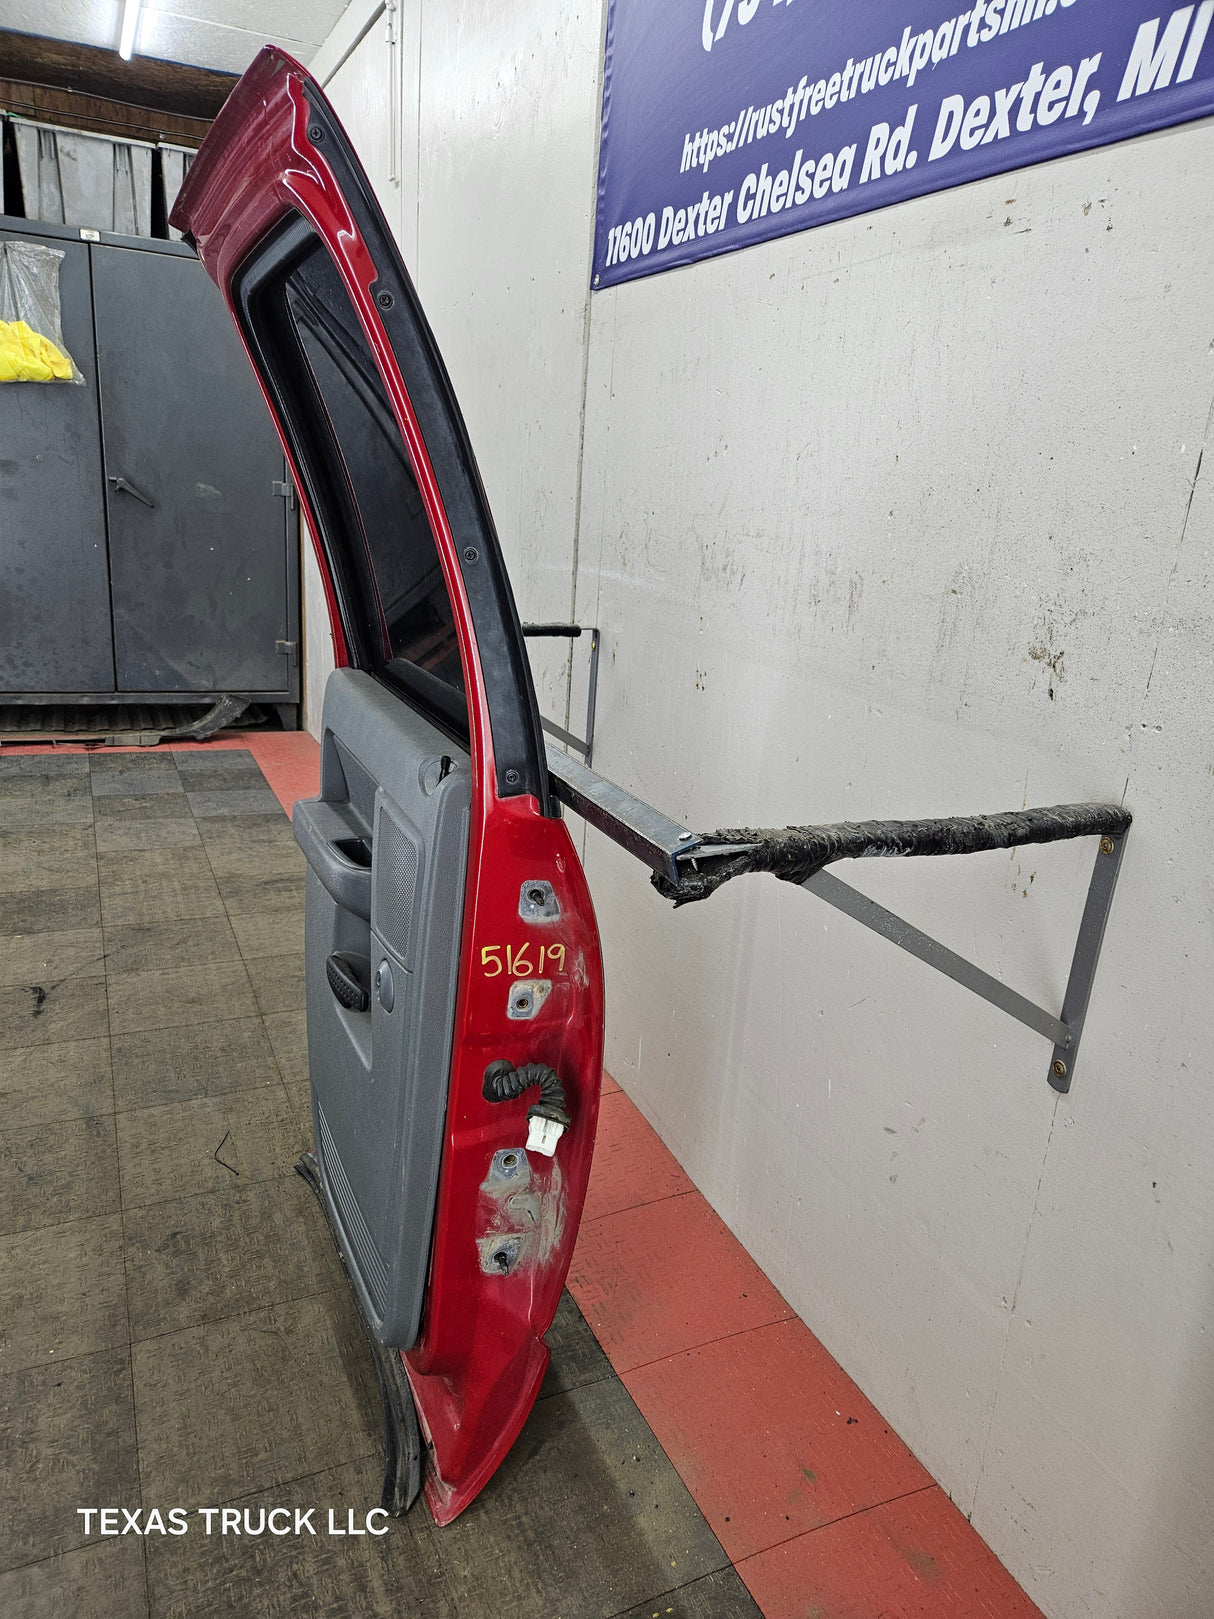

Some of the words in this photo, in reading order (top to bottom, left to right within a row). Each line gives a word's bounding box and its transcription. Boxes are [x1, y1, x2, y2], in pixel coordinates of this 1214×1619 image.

[606, 212, 656, 267] 11600
[658, 190, 735, 250] Dexter
[737, 144, 858, 224] Chelsea
[859, 104, 919, 185] Rd.
[928, 52, 1103, 162] Dexter,
[1116, 0, 1214, 102] MI
[481, 942, 566, 978] 51619
